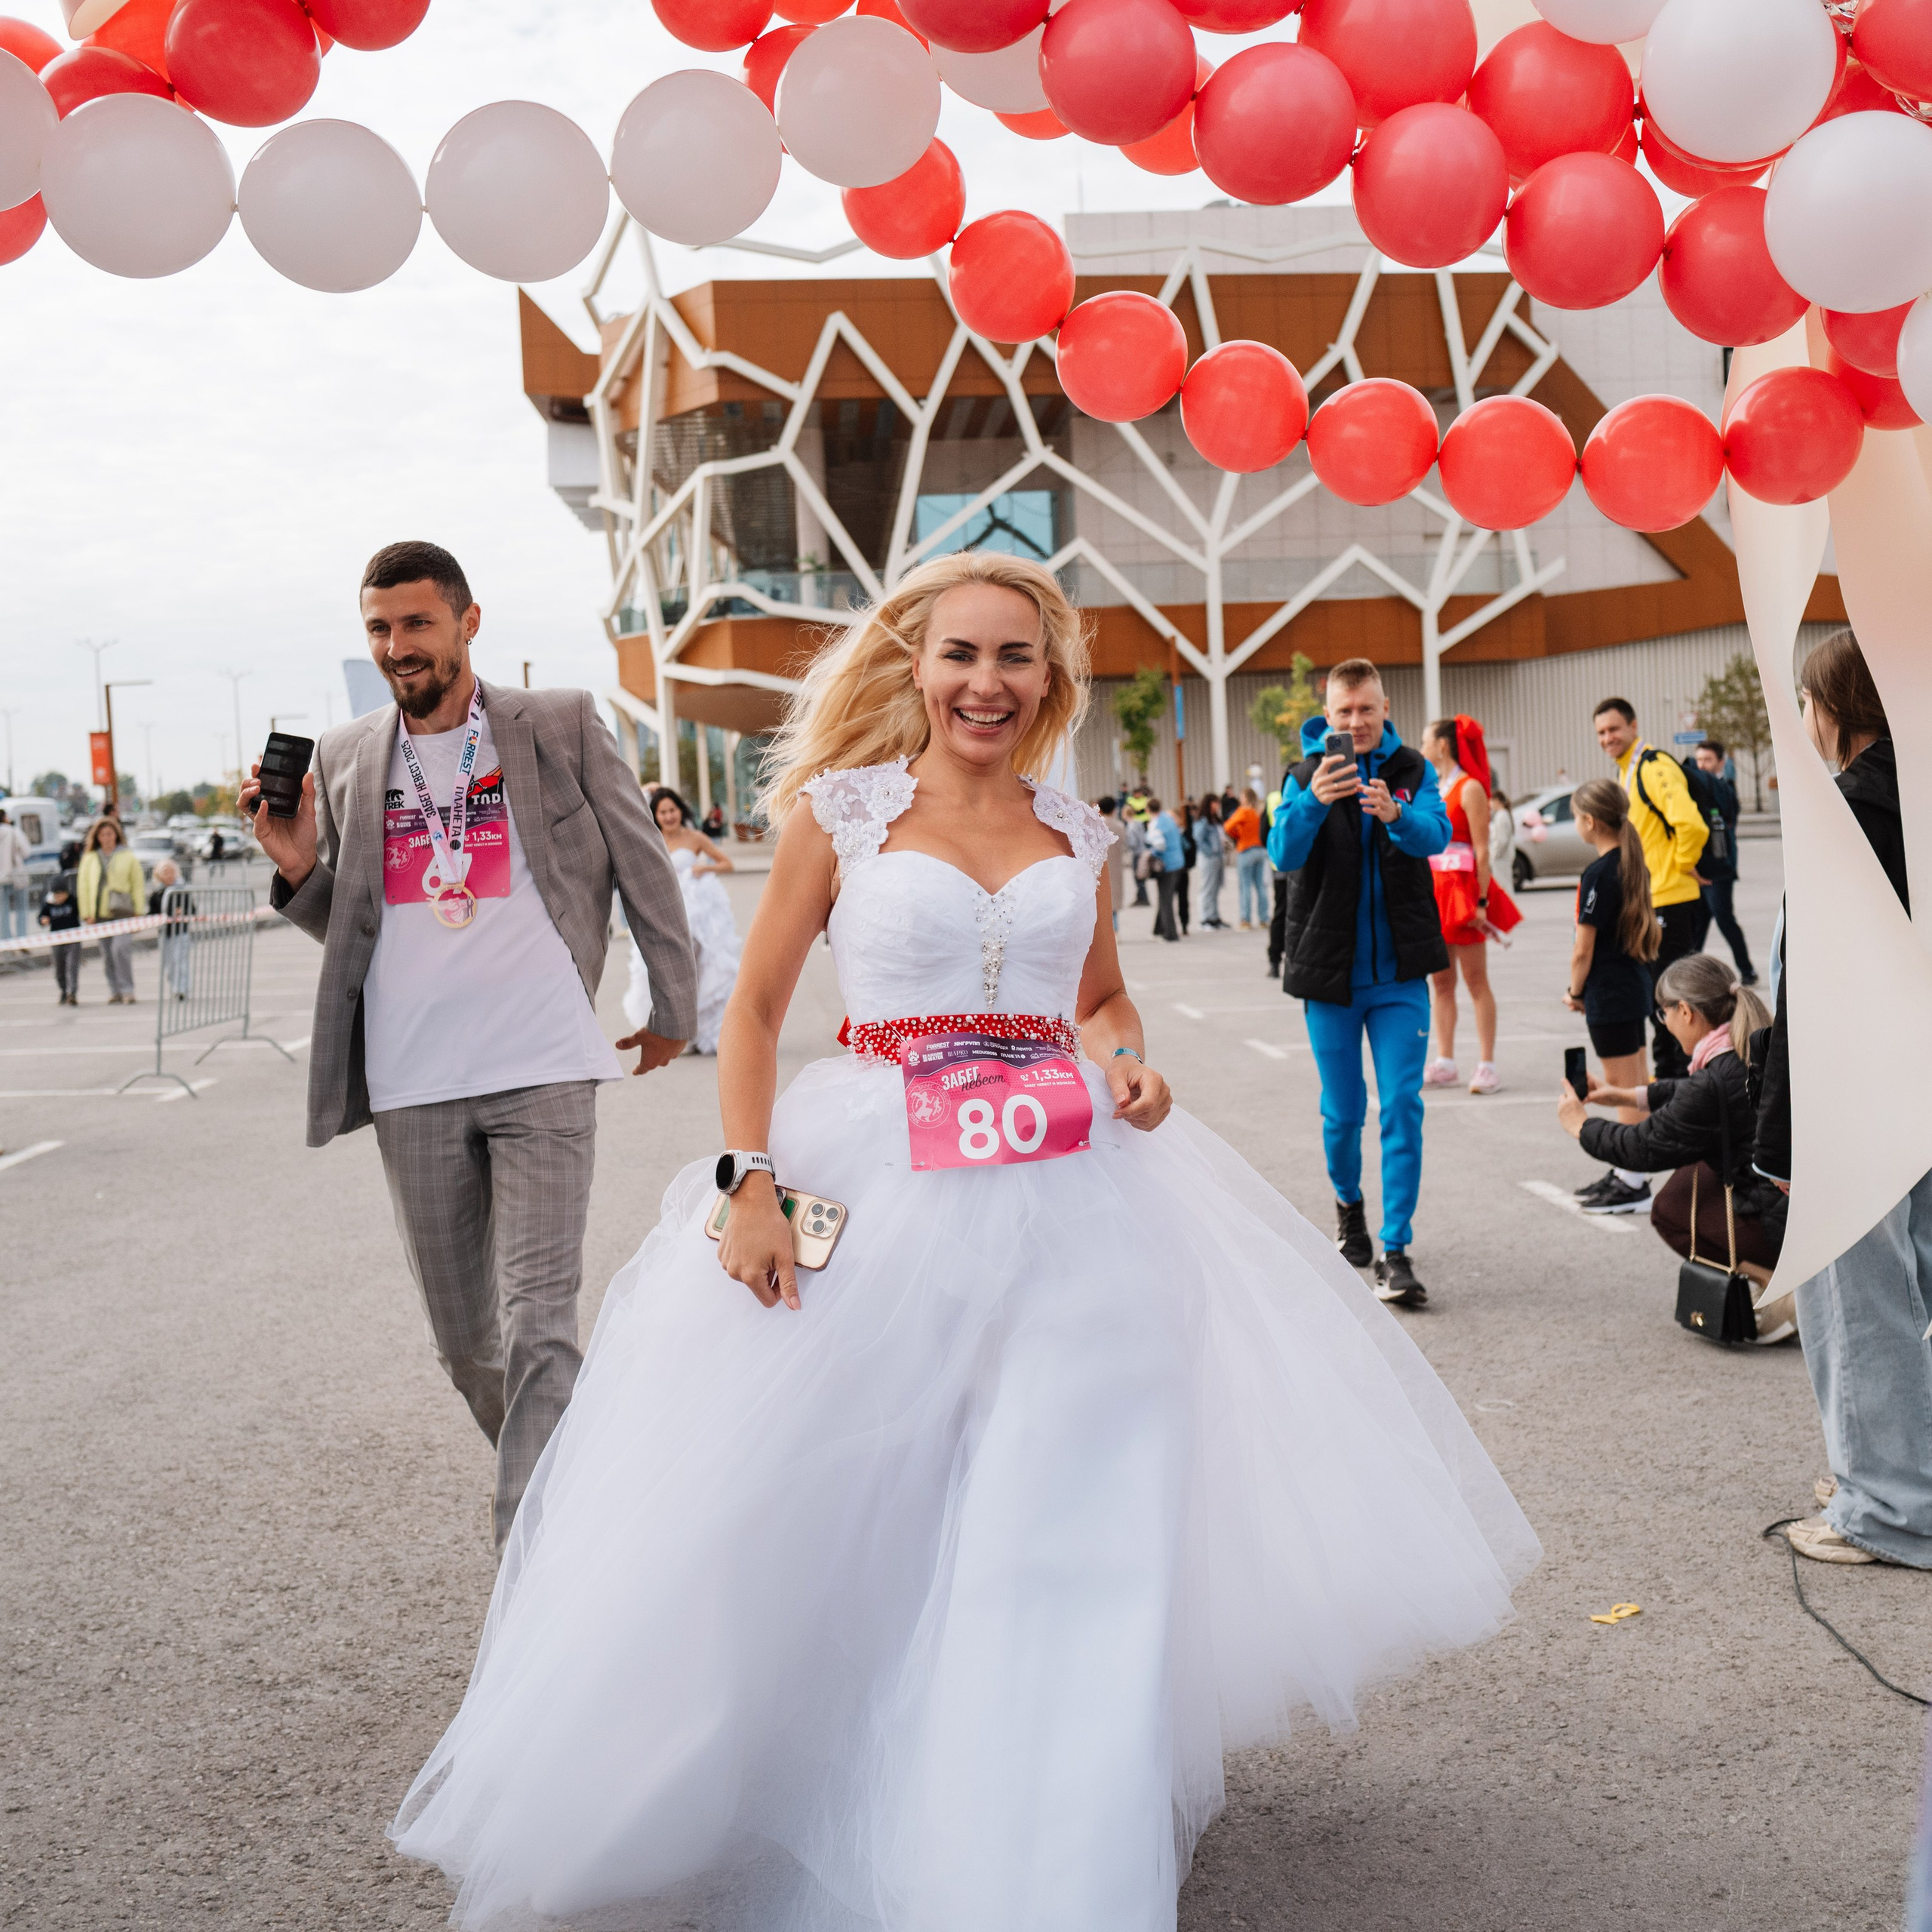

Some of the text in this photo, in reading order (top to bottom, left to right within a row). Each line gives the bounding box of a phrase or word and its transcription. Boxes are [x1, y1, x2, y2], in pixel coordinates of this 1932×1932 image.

[462, 729, 479, 776] FORREST
[401, 740, 436, 818] ЗАБЕГ НЕВЕСТ 2025
[385, 801, 405, 811] TREK
[451, 786, 464, 837] ПЛАНЕТА
[408, 834, 431, 848] ЗАБЕ
[1440, 854, 1460, 872] 73
[926, 1041, 949, 1051] FORREST
[941, 1066, 980, 1091] ЗАБЕГ
[961, 1073, 1005, 1091] невест
[909, 1112, 919, 1124] 2025
[957, 1094, 1048, 1159] 80
